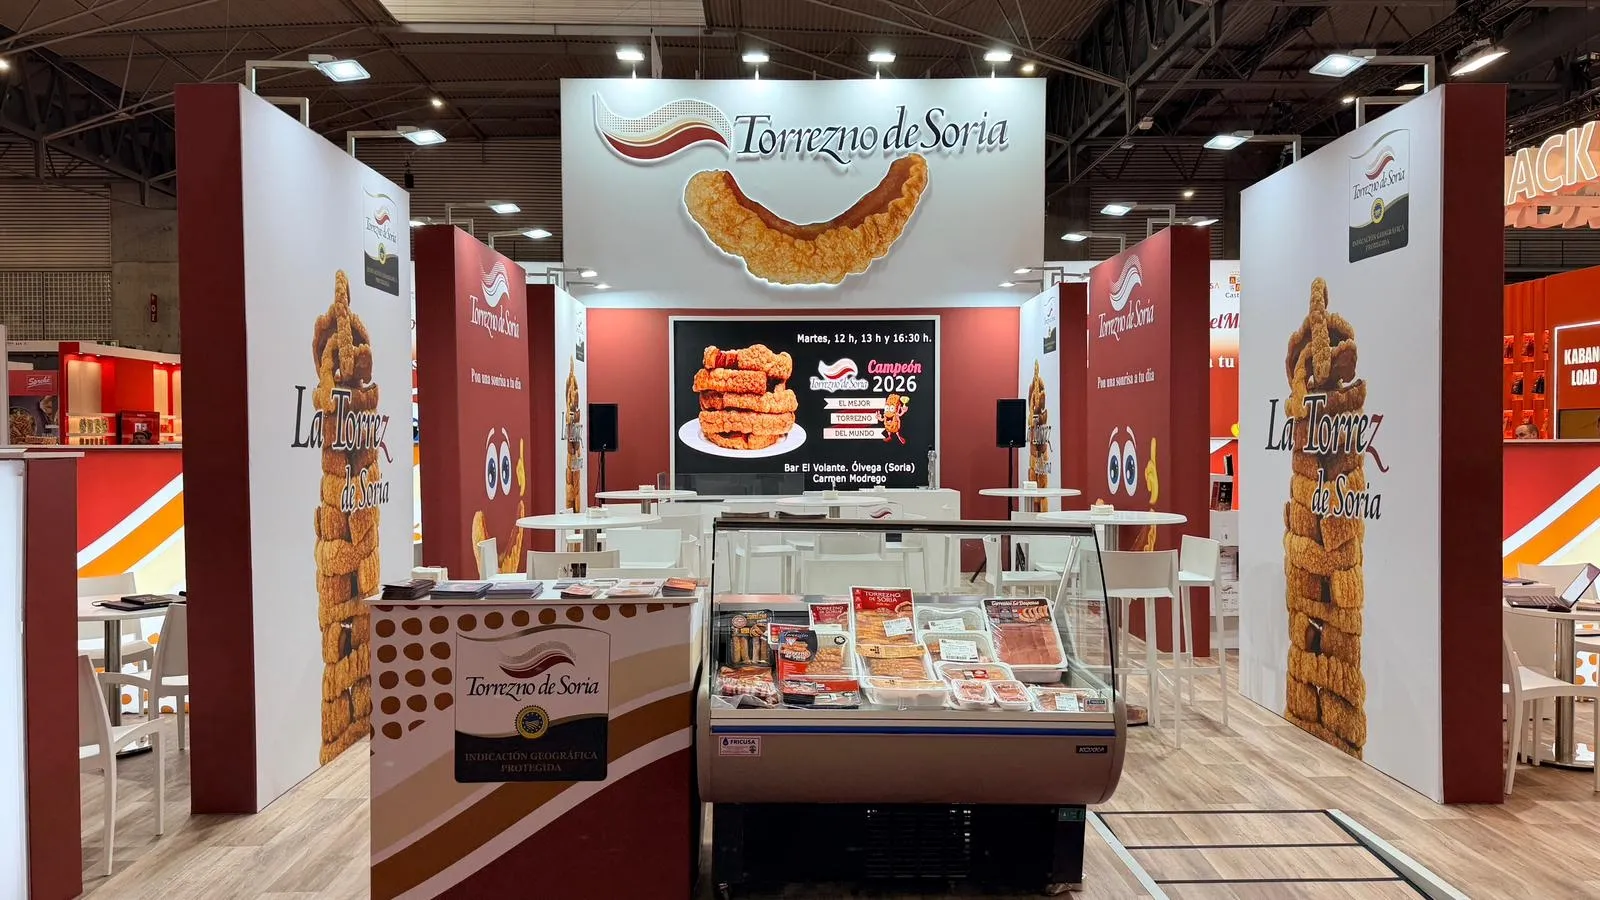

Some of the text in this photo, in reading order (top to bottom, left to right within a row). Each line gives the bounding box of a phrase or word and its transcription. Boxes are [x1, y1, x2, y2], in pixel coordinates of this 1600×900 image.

[735, 105, 1009, 164] Torrezno de Soria
[1387, 168, 1405, 186] Soria
[470, 295, 520, 338] Torrezno de Soria
[1099, 299, 1155, 341] Torrezno de Soria
[797, 334, 932, 345] Martes, 12 h, 13 h y 16:30 h.
[868, 359, 922, 377] Campeón
[1218, 356, 1235, 368] tu
[471, 368, 481, 383] Pon
[872, 375, 917, 392] 2026
[1571, 368, 1598, 387] LOAD
[290, 385, 393, 464] La Torrez
[1265, 394, 1390, 473] La Torrez
[784, 460, 916, 474] Bar El Volante. Ólvega (Soria)
[812, 474, 887, 484] Carmen Modrego
[342, 465, 390, 512] de Soria
[1312, 469, 1382, 520] de Soria
[466, 673, 600, 702] Torrezno de Soria
[465, 750, 598, 762] INDICACIÓN GEOGRÁFICA
[501, 763, 562, 773] PROTEGIDA
